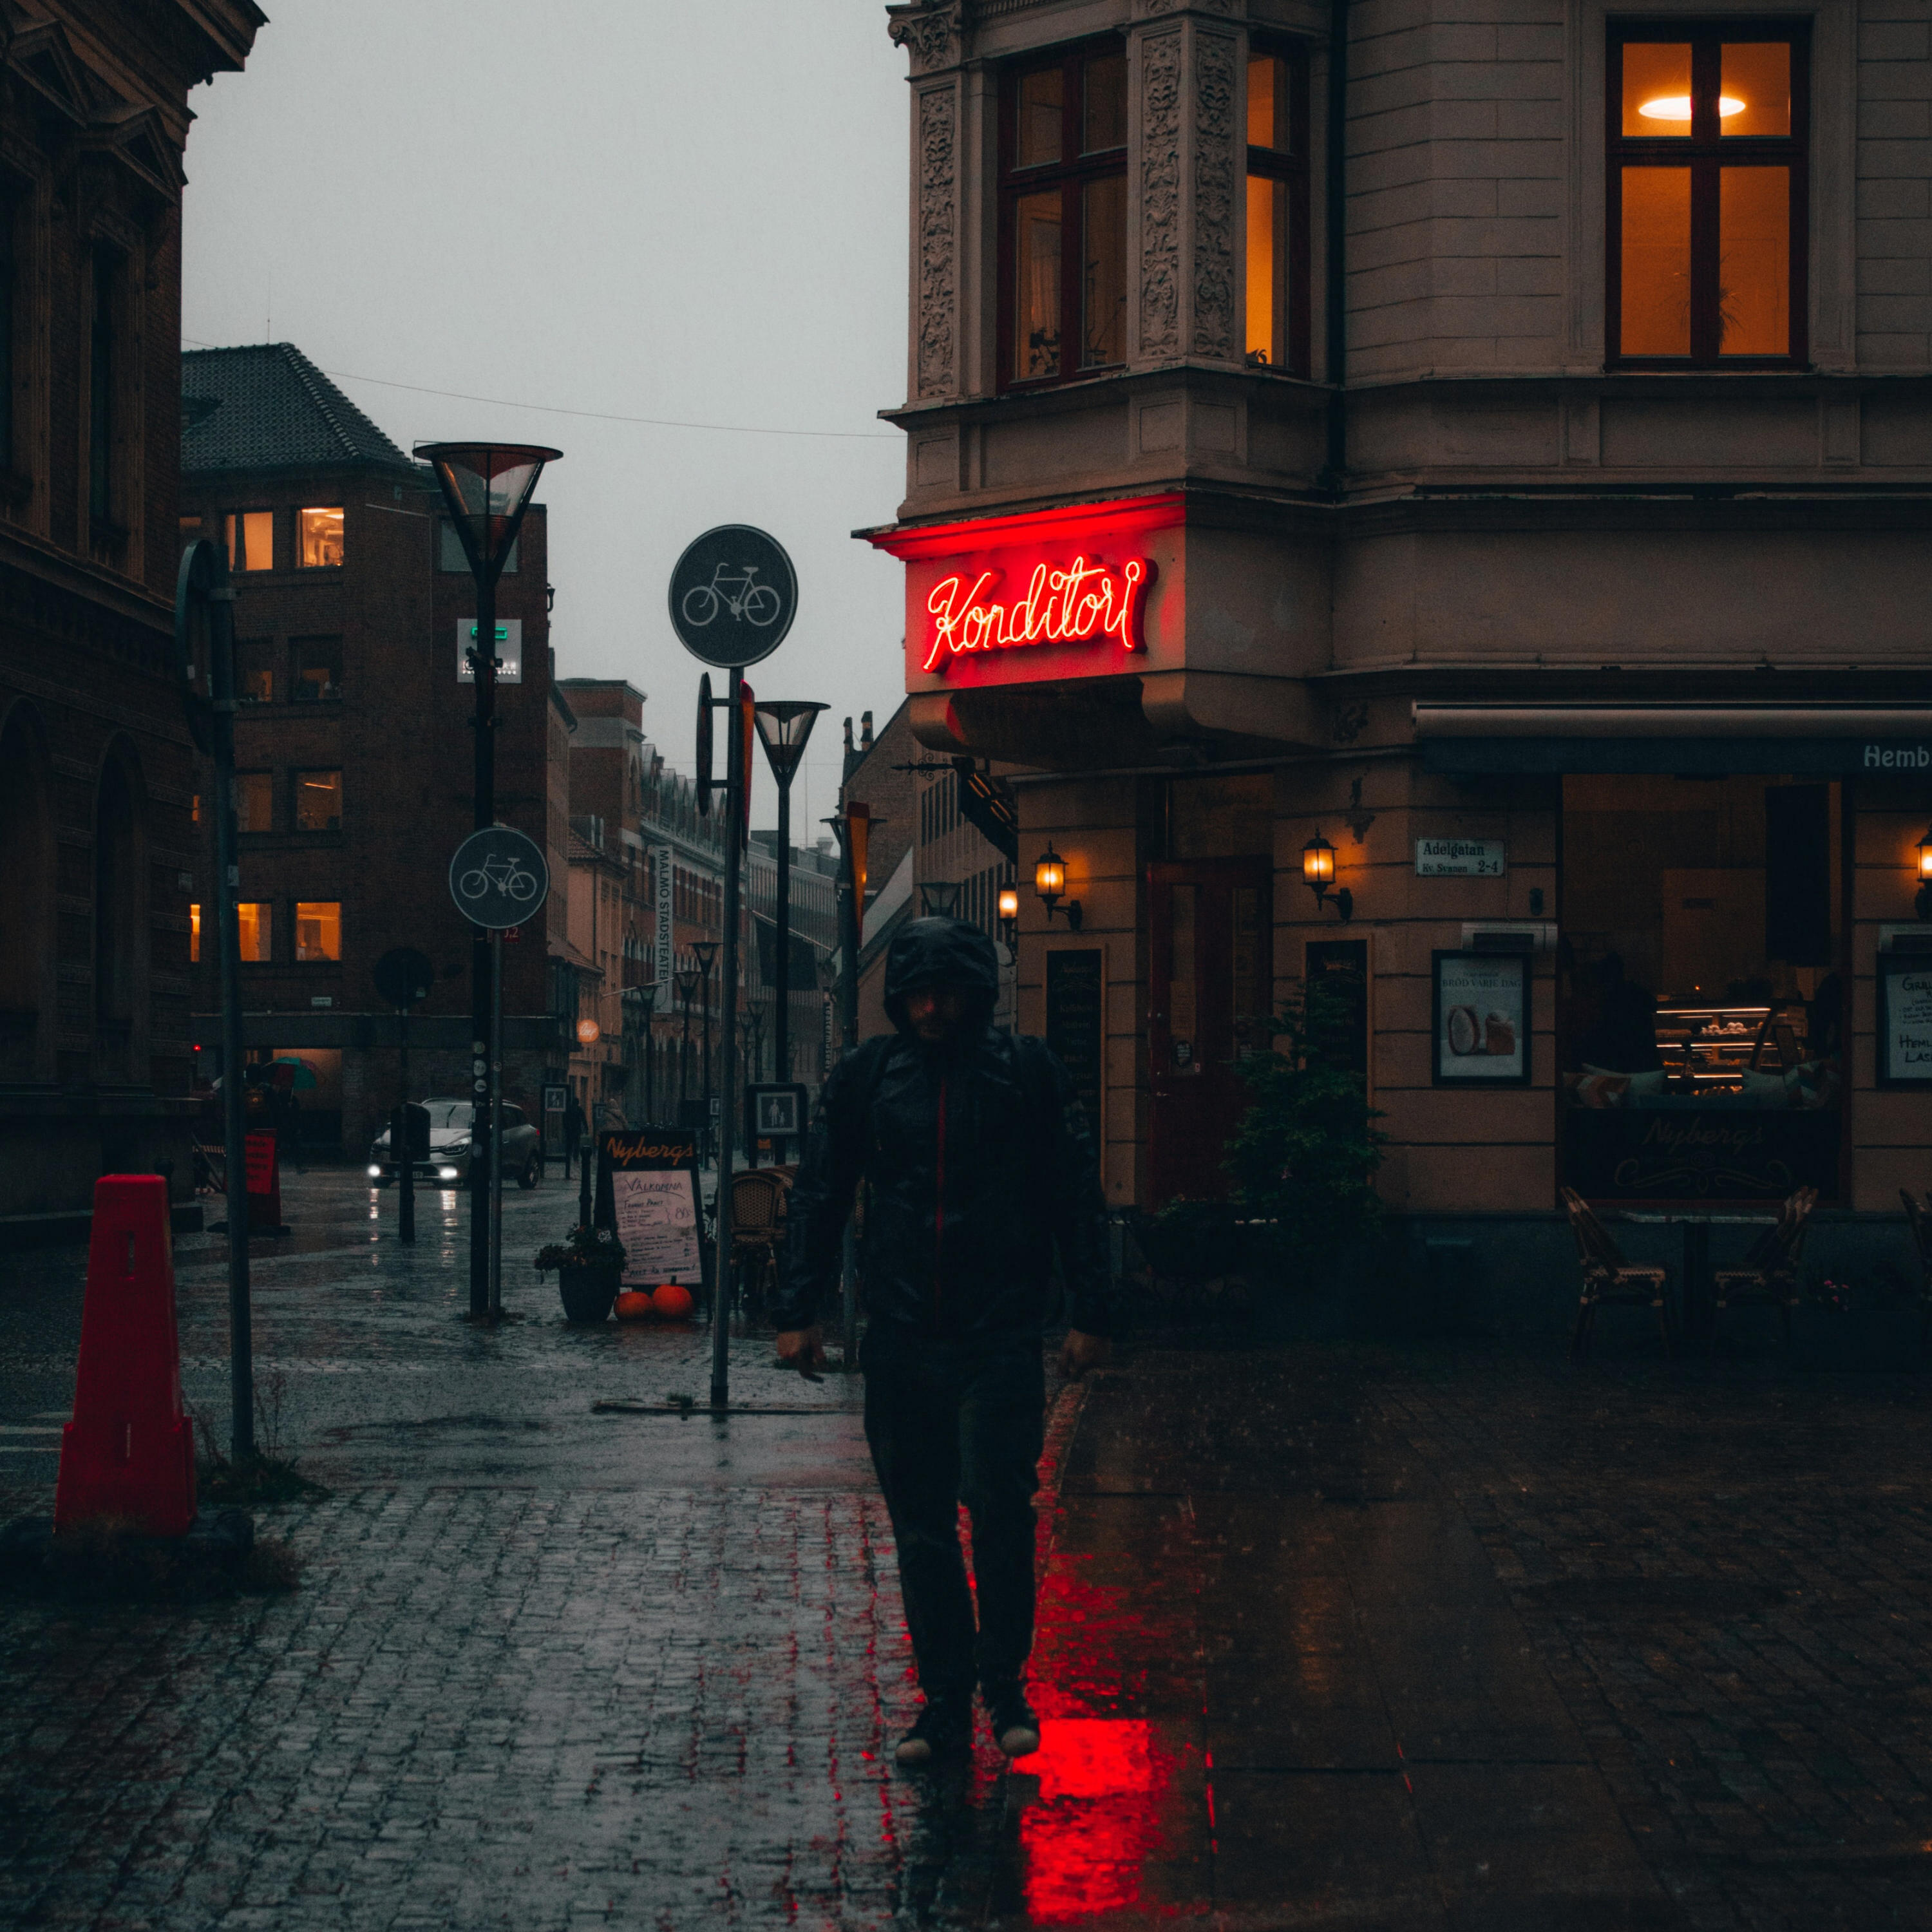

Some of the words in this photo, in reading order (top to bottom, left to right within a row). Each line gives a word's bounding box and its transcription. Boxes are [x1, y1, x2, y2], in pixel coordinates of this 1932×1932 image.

[921, 554, 1141, 672] Konditori
[1864, 745, 1932, 767] Hemb
[1423, 842, 1484, 859] Adelgatan
[659, 850, 670, 898] MALMÖ
[1437, 864, 1468, 873] Svanen
[1478, 860, 1498, 873] 2-4
[1442, 977, 1470, 987] BRÖD
[1905, 1052, 1932, 1063] LAS
[1642, 1116, 1764, 1155] Nybergs
[607, 1136, 694, 1166] Nybergs
